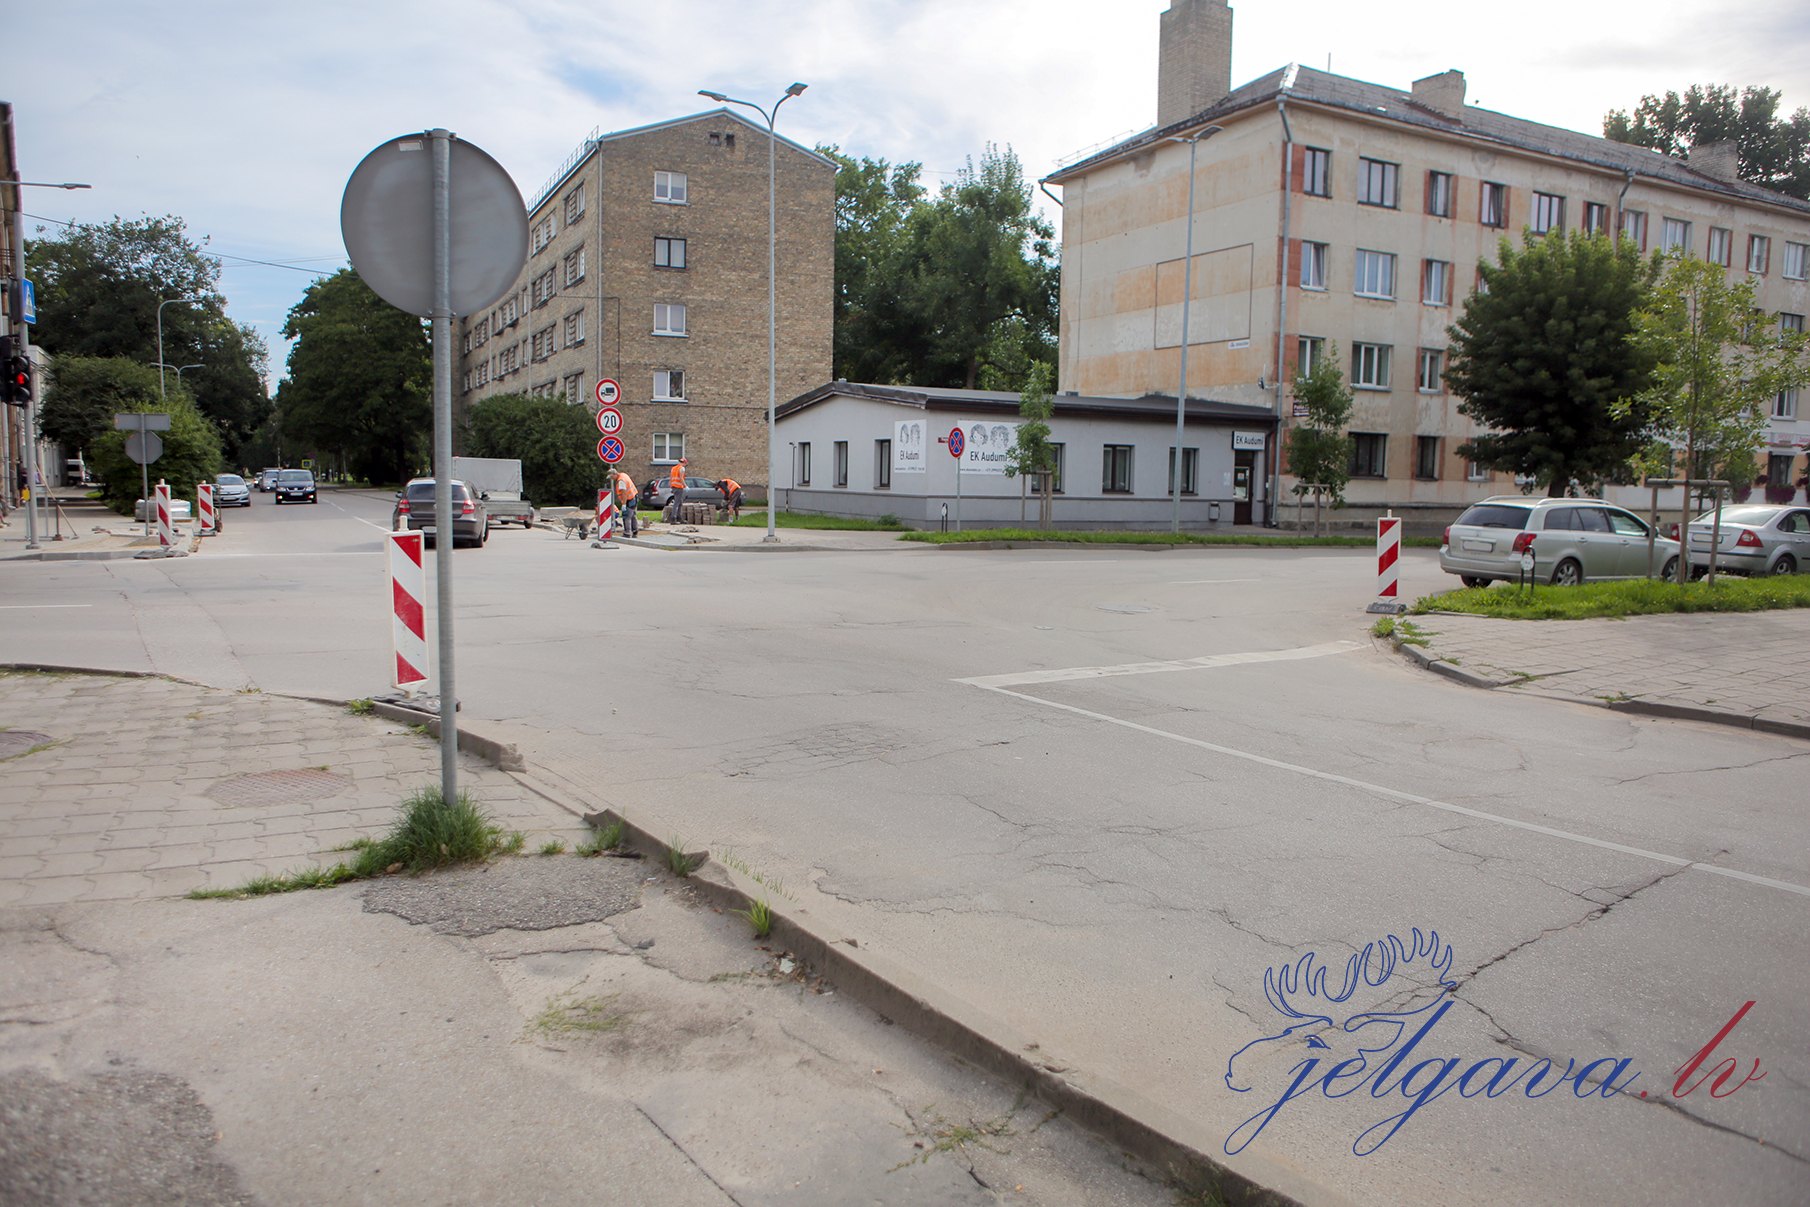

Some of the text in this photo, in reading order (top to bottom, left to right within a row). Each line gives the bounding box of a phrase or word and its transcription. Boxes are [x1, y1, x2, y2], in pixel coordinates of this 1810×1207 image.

[603, 414, 617, 428] 20
[1235, 435, 1264, 446] EK Audumi
[970, 450, 1008, 462] EK Audumi
